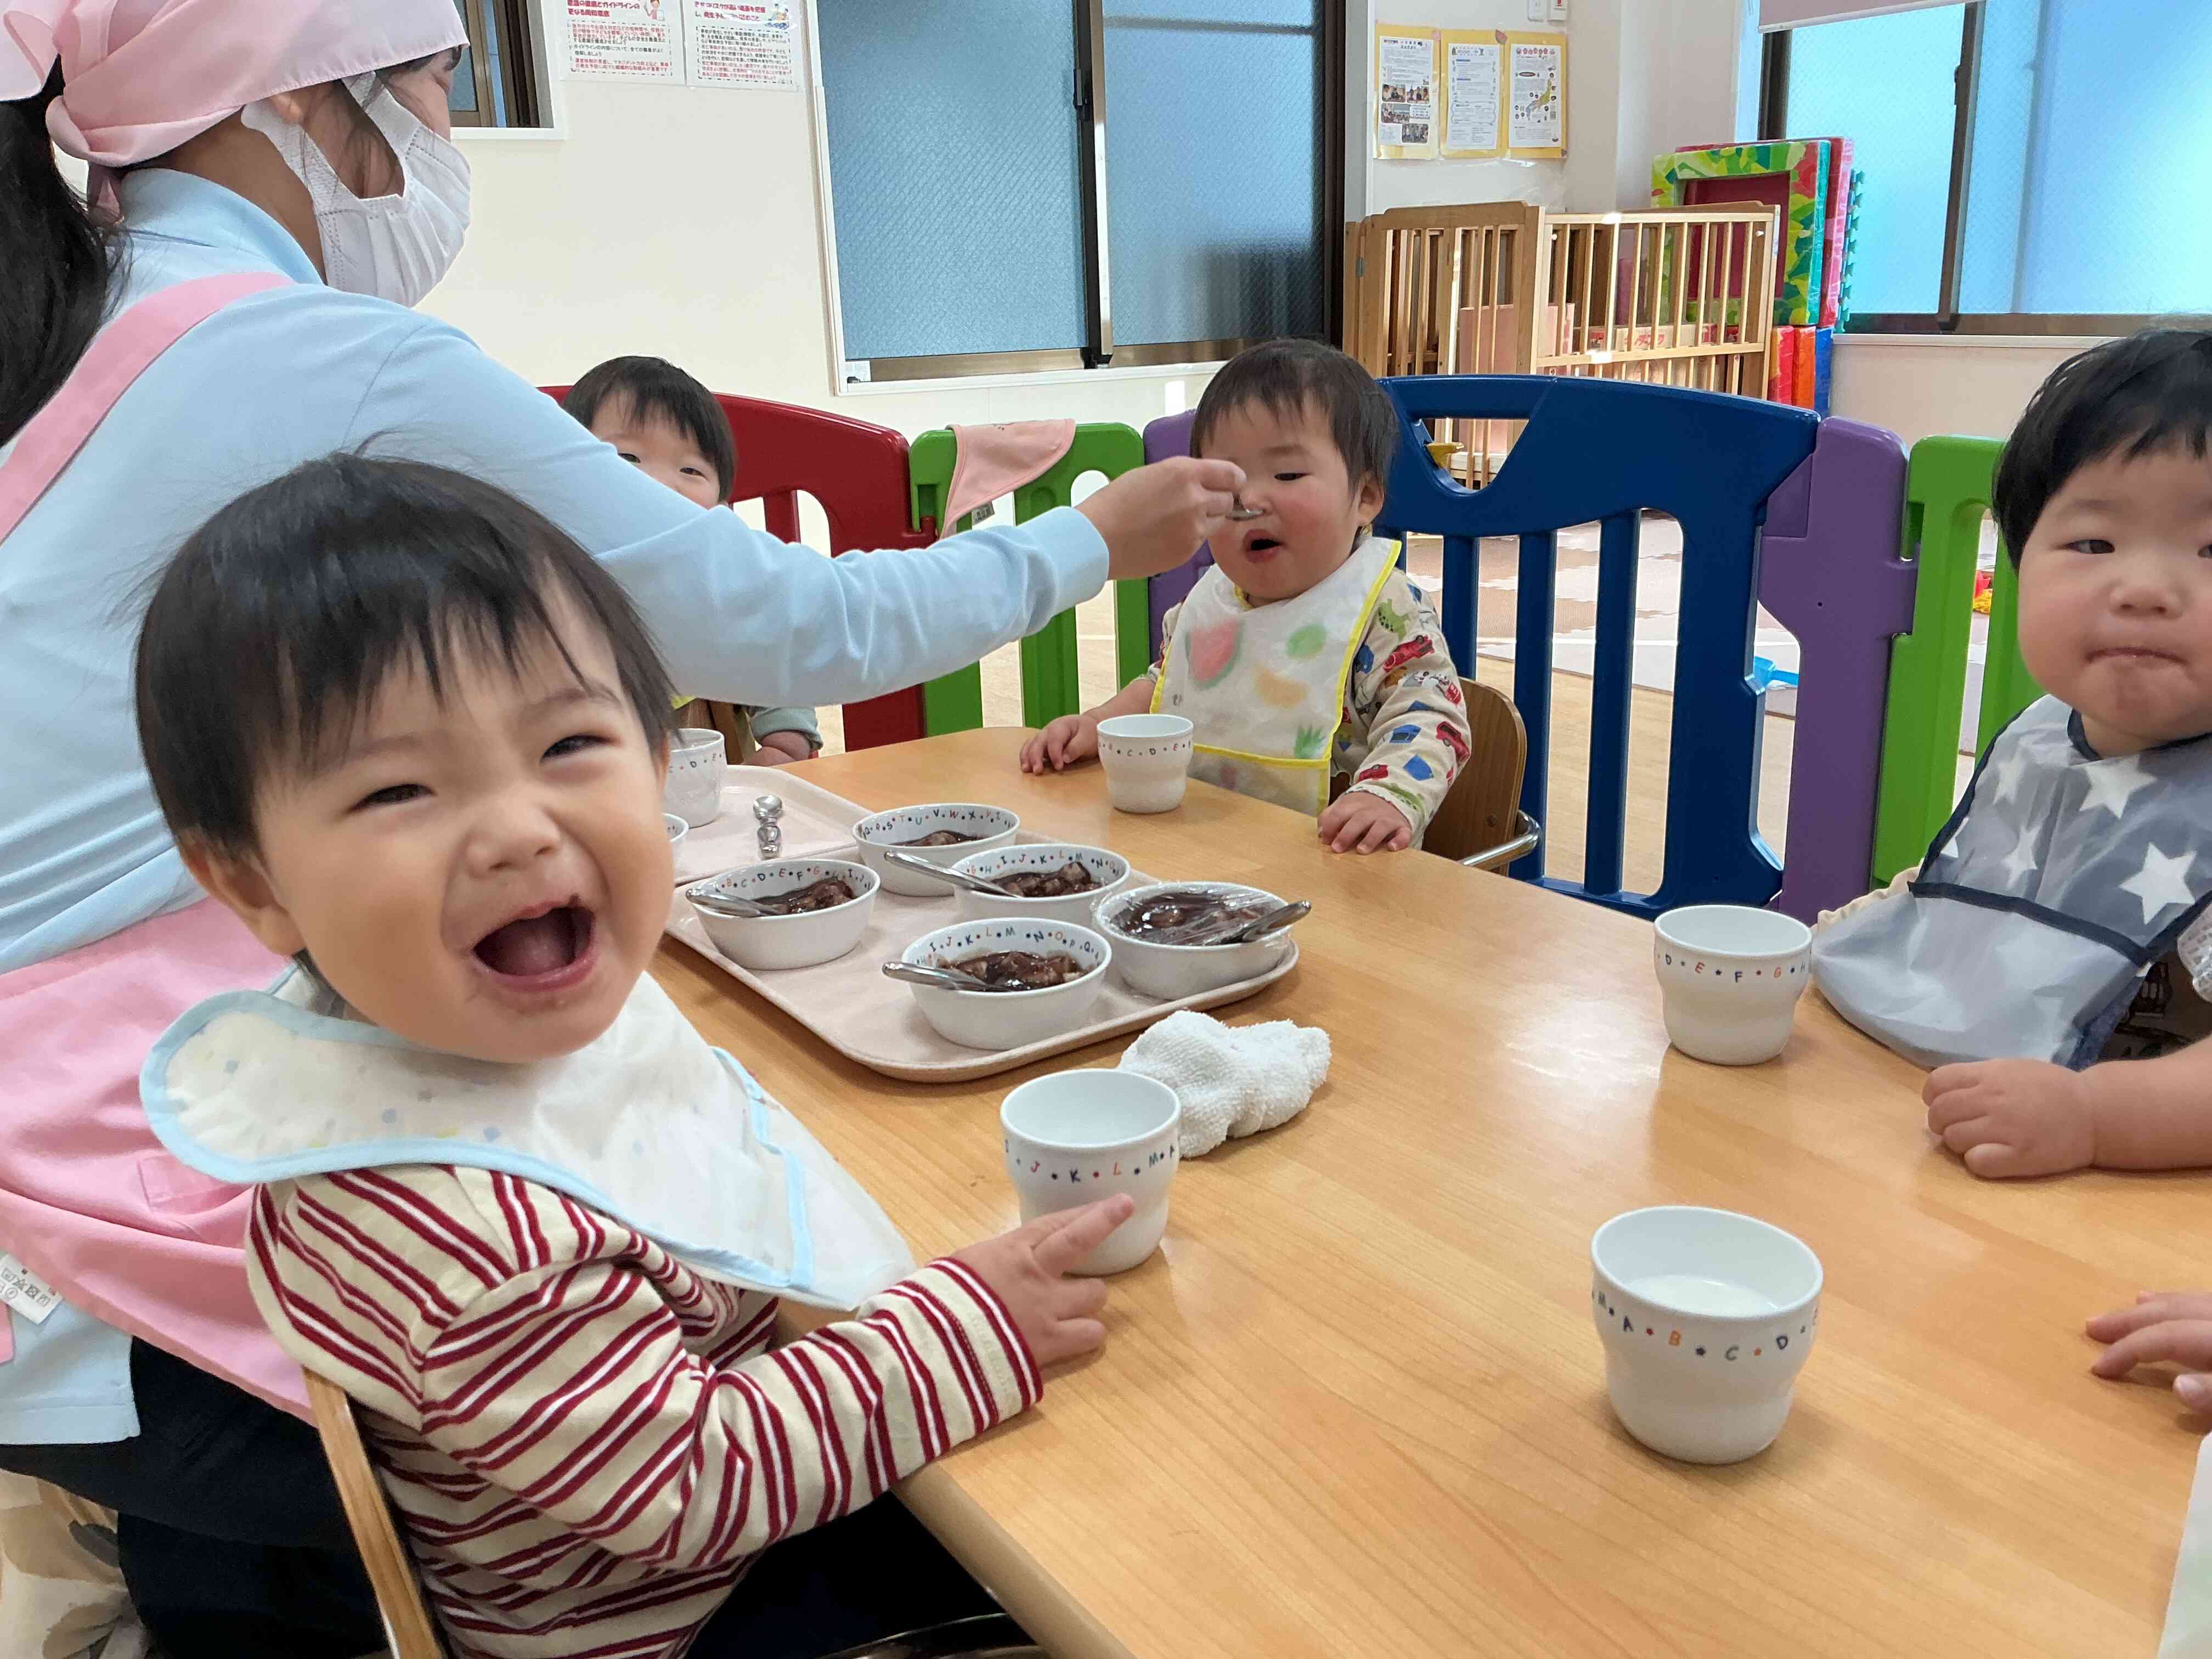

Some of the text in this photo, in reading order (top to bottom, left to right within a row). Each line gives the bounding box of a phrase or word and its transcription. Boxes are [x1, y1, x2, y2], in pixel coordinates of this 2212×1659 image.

[757, 873, 766, 882] D
[779, 868, 786, 877] E
[797, 871, 803, 881] F
[965, 935, 973, 945] K
[1033, 932, 1044, 943] N
[1665, 954, 1672, 966] D
[1695, 961, 1705, 974] E
[1734, 971, 1743, 983] F
[1030, 1160, 1040, 1173] J
[1069, 1169, 1081, 1183] K
[1113, 1162, 1121, 1176] L
[1623, 1316, 1633, 1333] A
[1668, 1329, 1681, 1347] B
[1725, 1345, 1739, 1362] C
[1776, 1335, 1788, 1350] D
